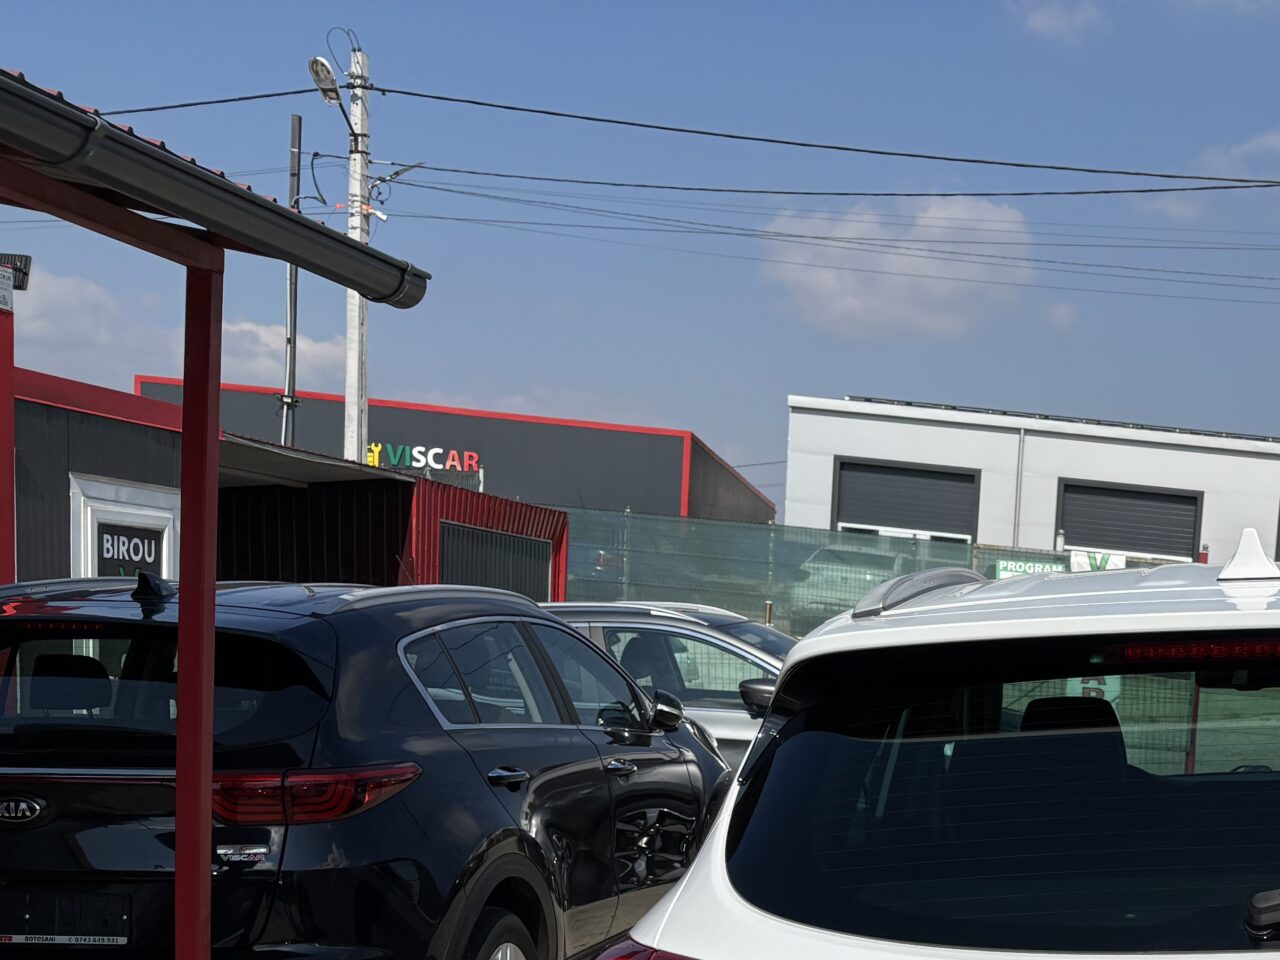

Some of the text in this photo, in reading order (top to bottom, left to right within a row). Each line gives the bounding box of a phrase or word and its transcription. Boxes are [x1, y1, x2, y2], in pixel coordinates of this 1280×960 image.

[386, 443, 479, 472] VISCAR
[103, 533, 156, 564] BIROU
[1000, 560, 1063, 573] PROGRAM
[0, 802, 31, 817] KIA
